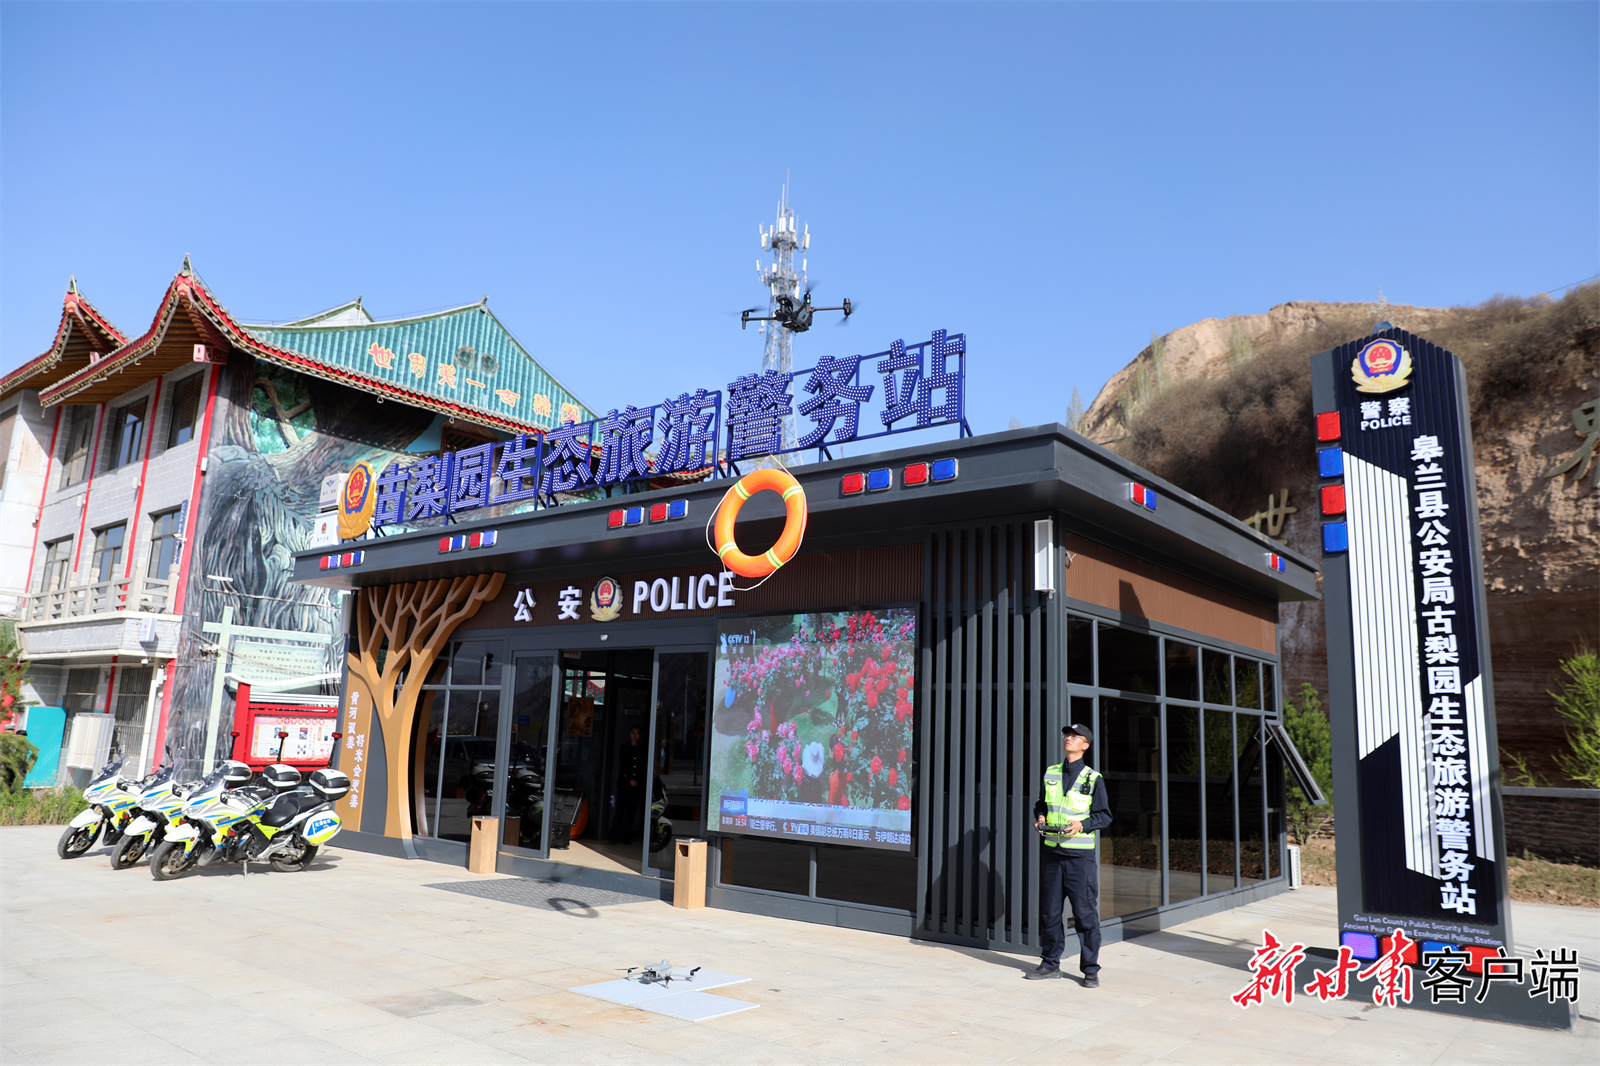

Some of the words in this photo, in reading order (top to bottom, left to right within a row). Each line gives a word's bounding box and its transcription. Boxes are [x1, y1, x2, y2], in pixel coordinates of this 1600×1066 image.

[1360, 397, 1411, 420] 警察
[1360, 415, 1412, 431] POLICE
[375, 329, 963, 526] 古梨园生态旅游警务站
[513, 586, 583, 622] 公安
[632, 571, 736, 614] POLICE
[1410, 434, 1477, 916] 皋兰县公安局古梨园生态旅游警务站
[1343, 922, 1369, 932] Ancient
[1370, 924, 1386, 933] Pear
[1414, 929, 1450, 941] Ecological
[1451, 933, 1473, 942] Police
[1474, 935, 1502, 945] Station
[1353, 914, 1368, 923] Gao
[1369, 915, 1380, 924] Lan
[1382, 917, 1408, 927] County
[1409, 919, 1430, 929] Public
[1432, 922, 1461, 933] Security
[1463, 926, 1490, 935] Bureau
